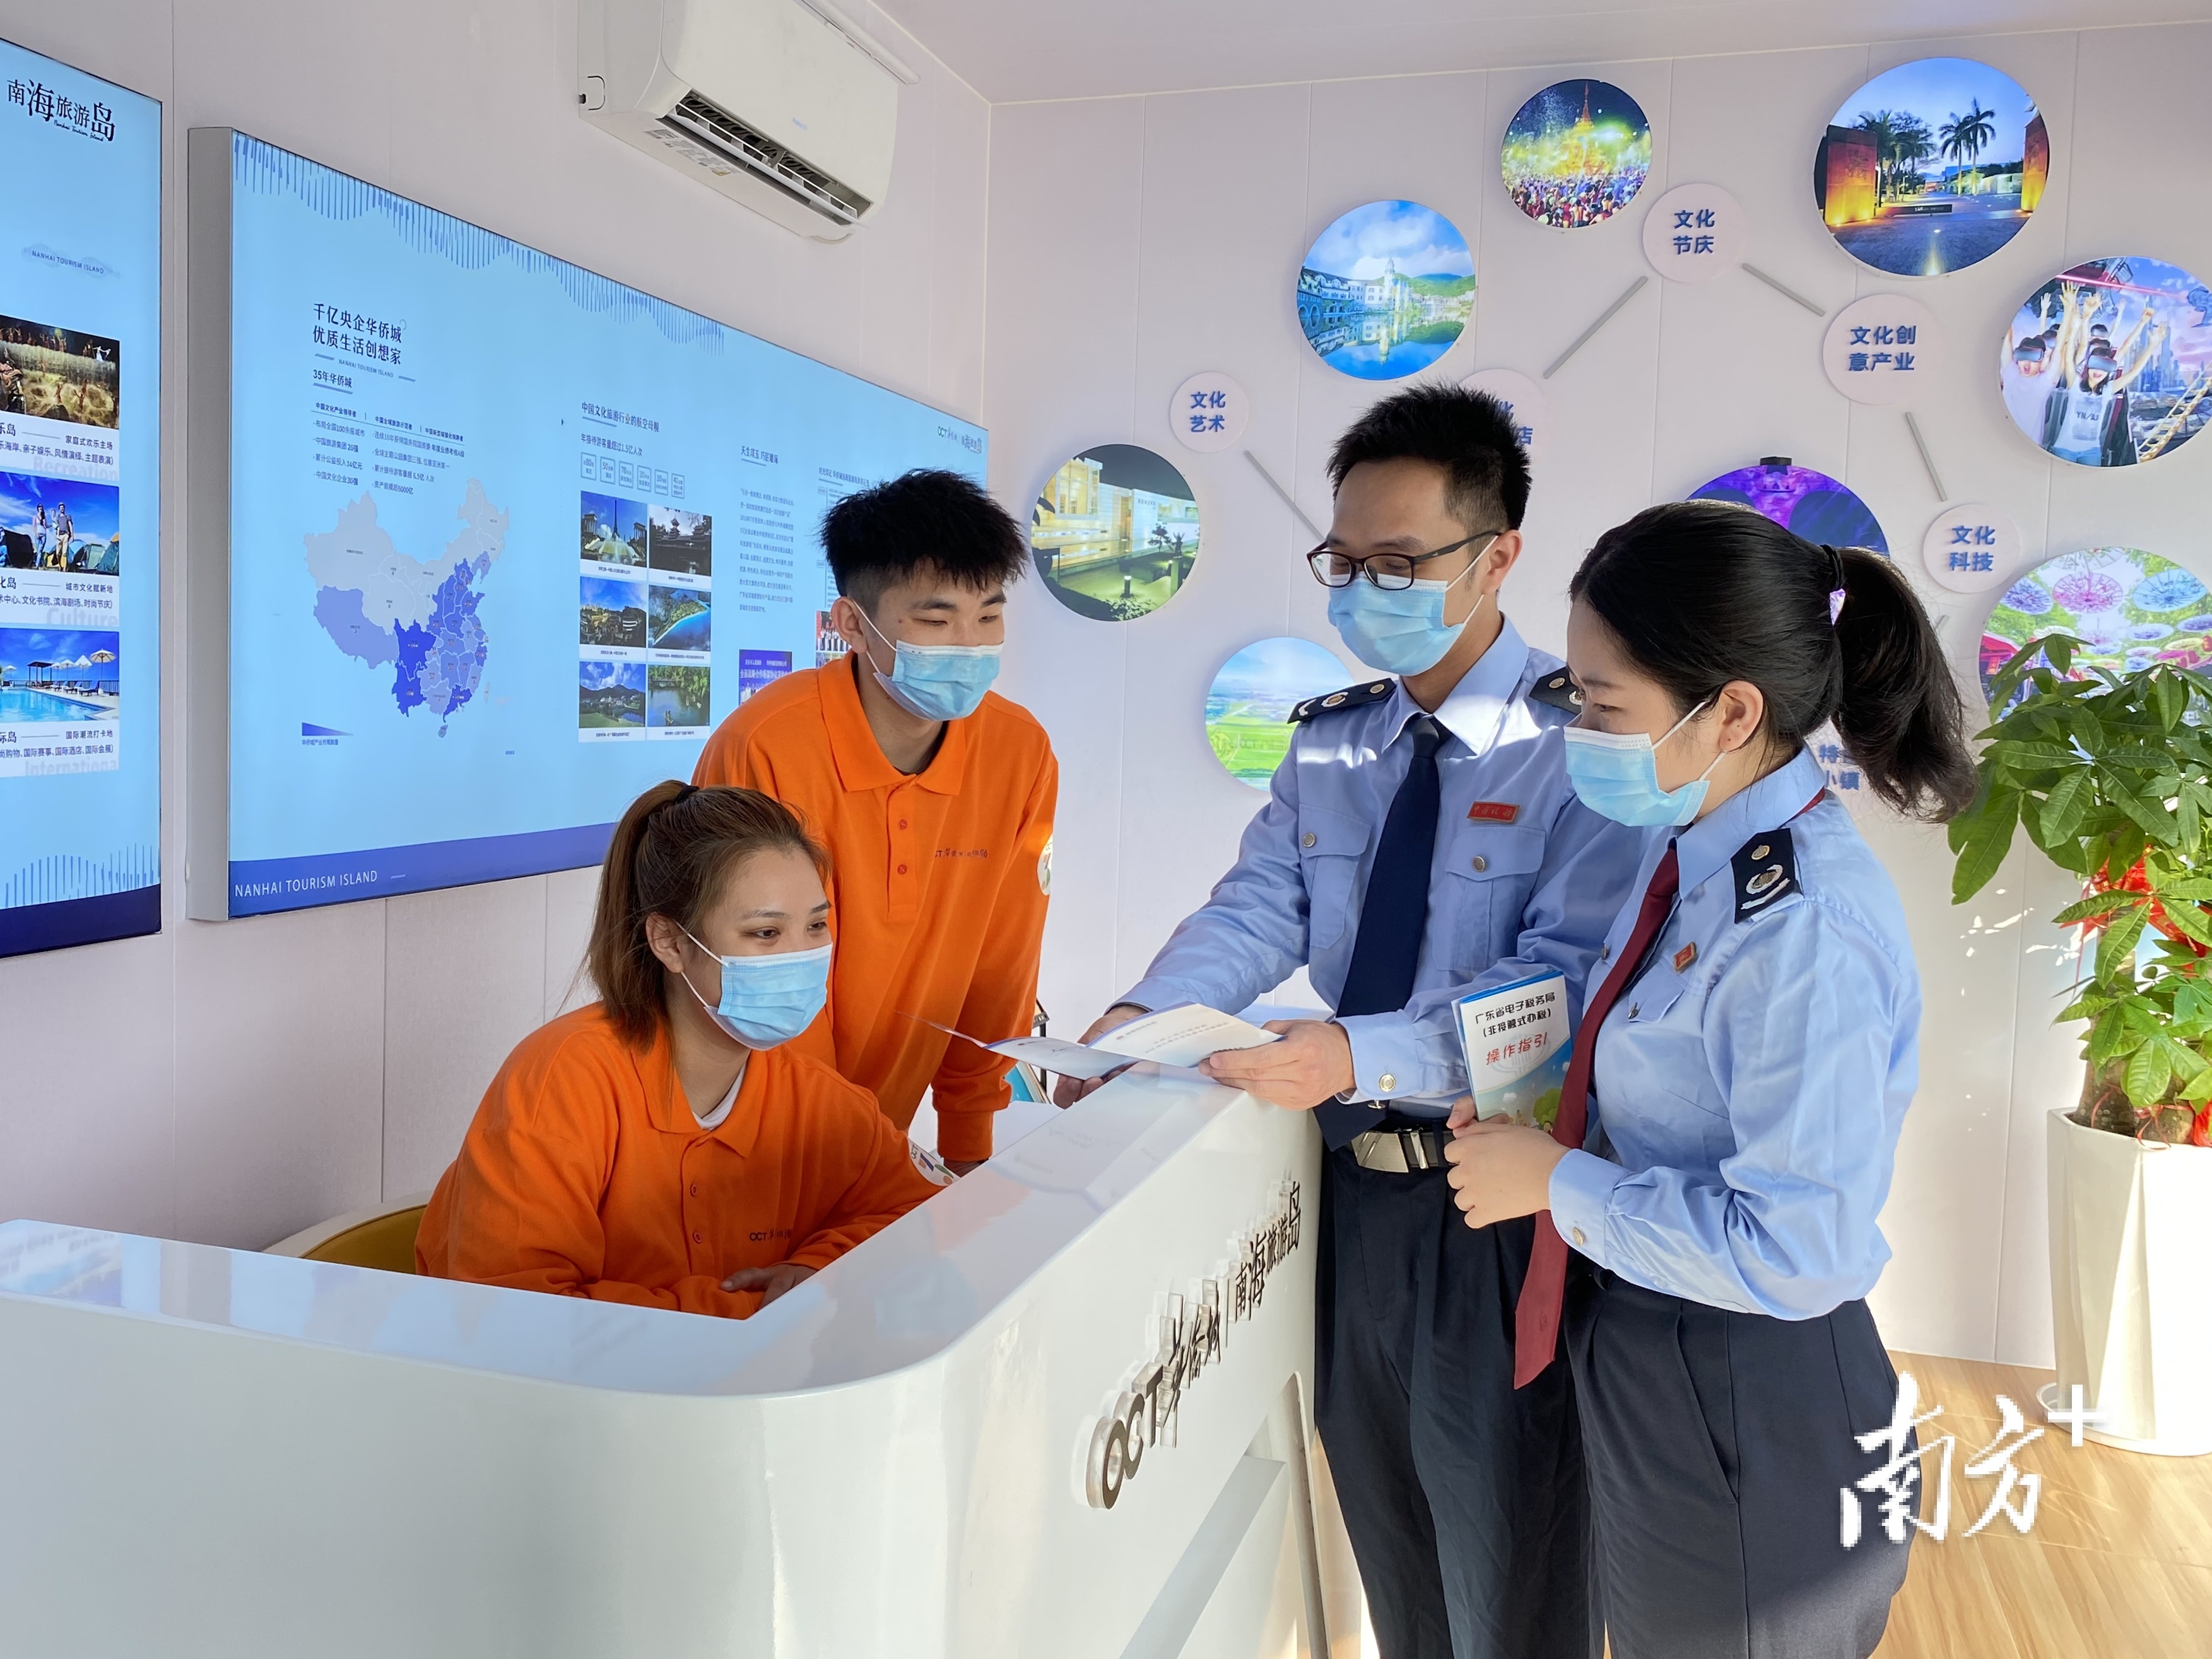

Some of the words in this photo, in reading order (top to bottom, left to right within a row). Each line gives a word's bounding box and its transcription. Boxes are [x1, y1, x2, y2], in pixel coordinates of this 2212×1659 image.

[7, 79, 115, 141] 南海旅游岛
[1673, 209, 1715, 229] 文化
[1673, 235, 1714, 255] 节庆
[32, 250, 56, 262] NANHAI
[57, 256, 82, 269] TOURISM
[83, 264, 104, 274] ISLAND
[313, 303, 402, 343] 千亿央企华侨城
[313, 325, 401, 365] 优质生活创想家
[1850, 325, 1917, 346] 文化创
[339, 359, 356, 368] NANHAI
[357, 363, 377, 373] TOURISM
[378, 369, 394, 378] ISLAND
[1849, 352, 1915, 372] 意产业
[313, 369, 352, 389] 35年华侨城
[1191, 390, 1226, 409] 文化
[1190, 414, 1225, 433] 艺术
[66, 435, 113, 450] 家庭式欢乐主场
[1951, 525, 1996, 546] 文化
[1948, 551, 1994, 573] 科技
[66, 729, 113, 740] 国际潮流打卡地
[234, 881, 282, 898] NANHAI
[286, 874, 336, 893] TOURISM
[339, 869, 378, 887] ISLAND
[1475, 992, 1556, 1024] 广东省电子税务局
[1486, 1032, 1548, 1065] 操作指引
[749, 1231, 767, 1241] OCT
[1086, 1363, 1163, 1510] OCT
